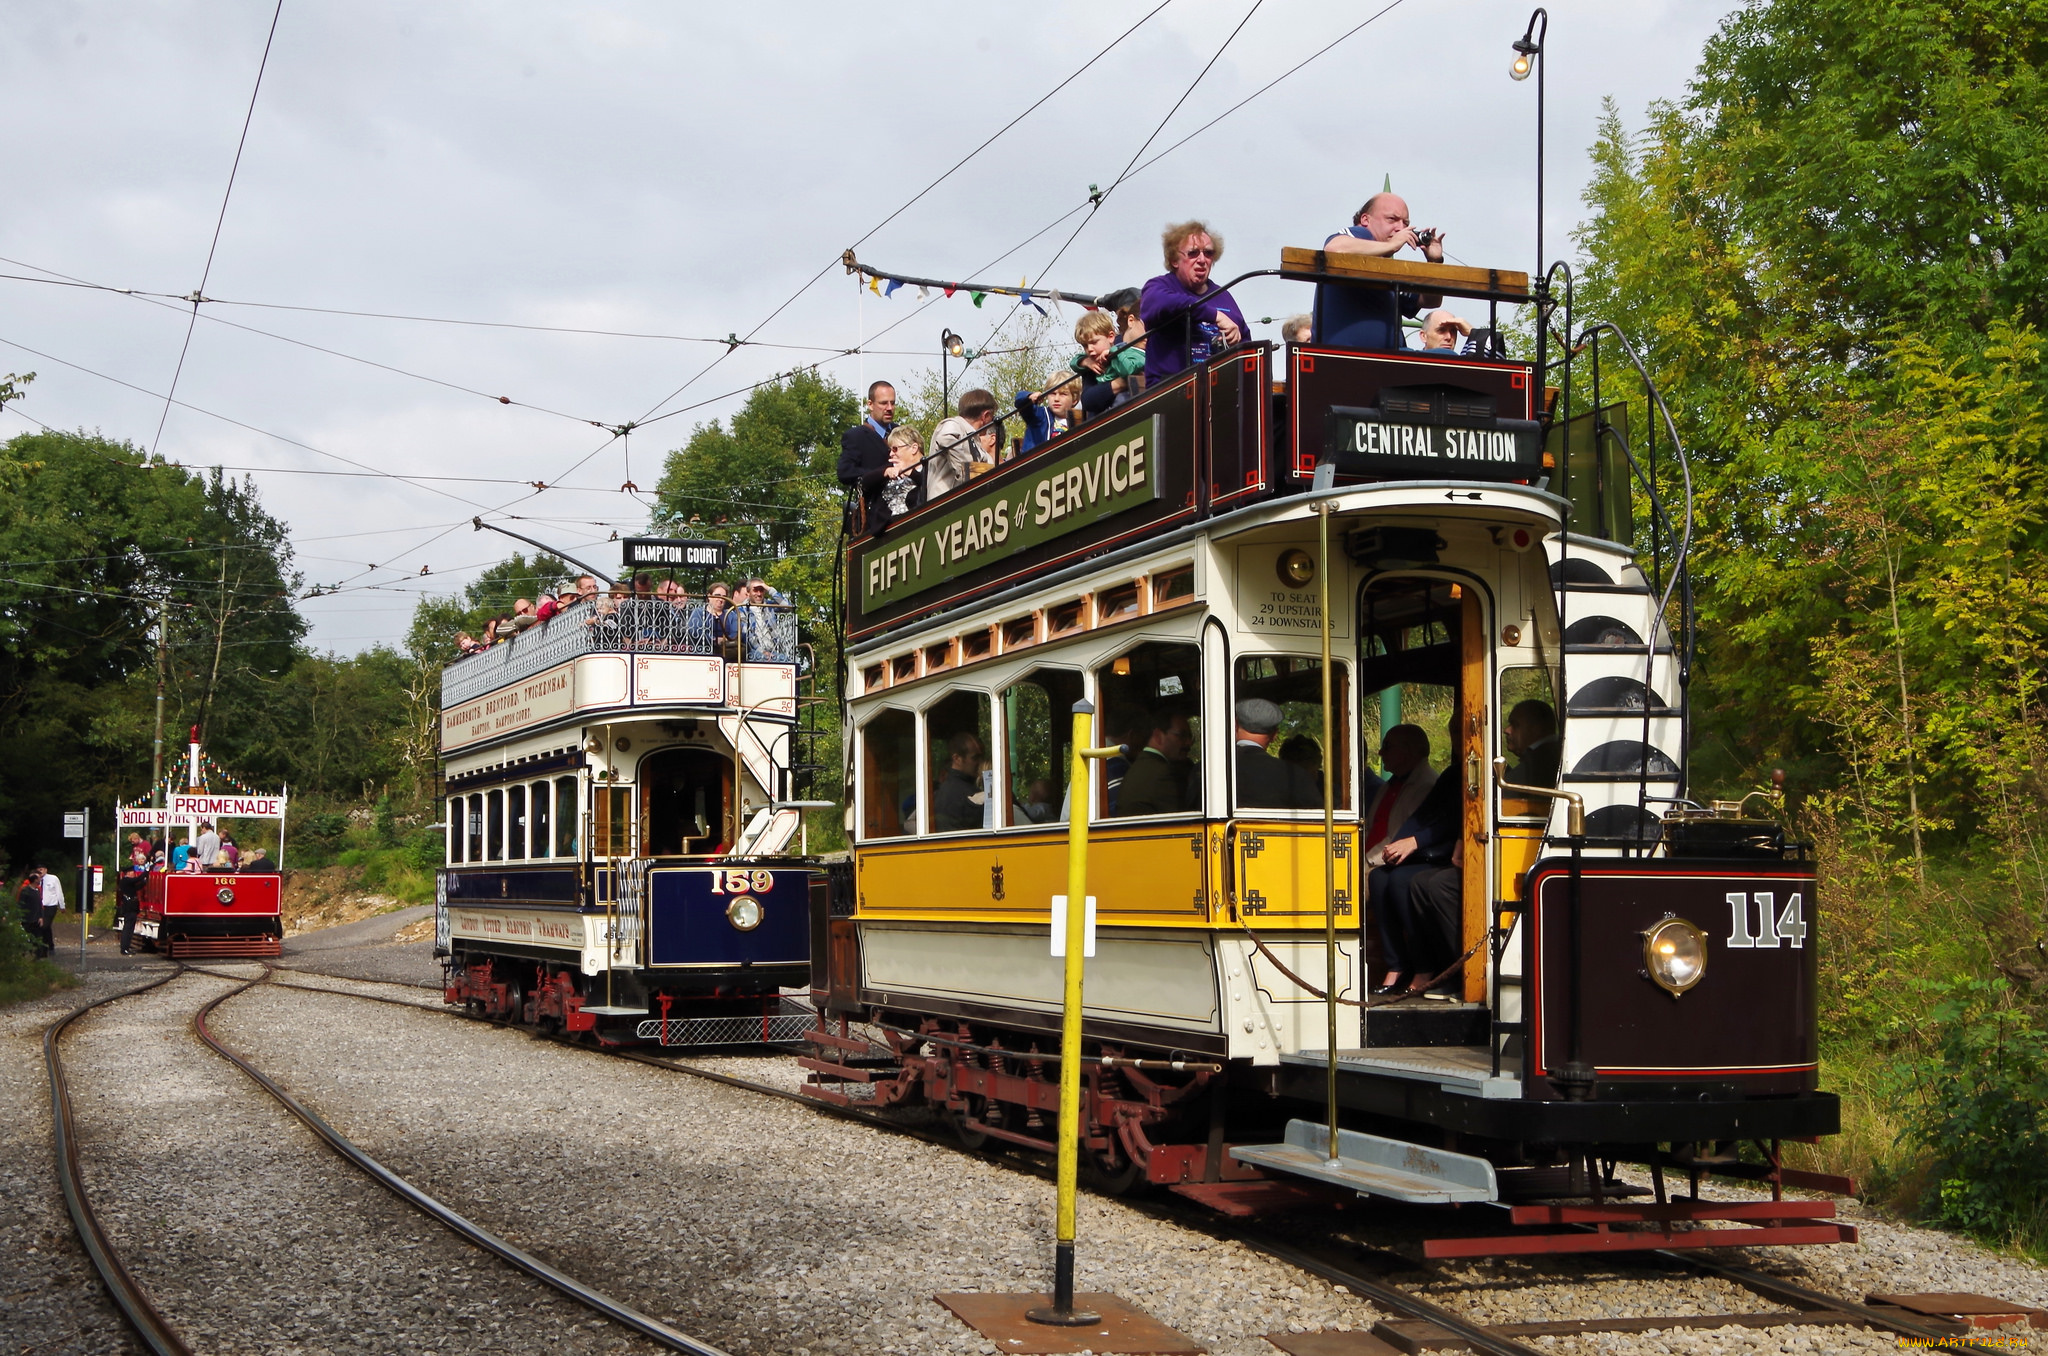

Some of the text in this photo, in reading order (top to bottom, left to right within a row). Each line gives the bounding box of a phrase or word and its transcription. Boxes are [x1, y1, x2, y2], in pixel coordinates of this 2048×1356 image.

[1355, 421, 1516, 463] CENTRAL STATION
[869, 436, 1146, 597] FIFTY YEARS of SERVICE
[634, 545, 718, 564] HAMPTON COURT
[1270, 592, 1317, 604] TO SEAT
[1260, 603, 1323, 617] 29 UPSTAIR
[1251, 616, 1335, 630] 24 DOWNSTAIS
[175, 797, 279, 815] PROMENADE
[123, 811, 153, 824] TOUR
[214, 877, 237, 886] 166
[711, 869, 774, 896] 159
[1725, 892, 1807, 949] 114
